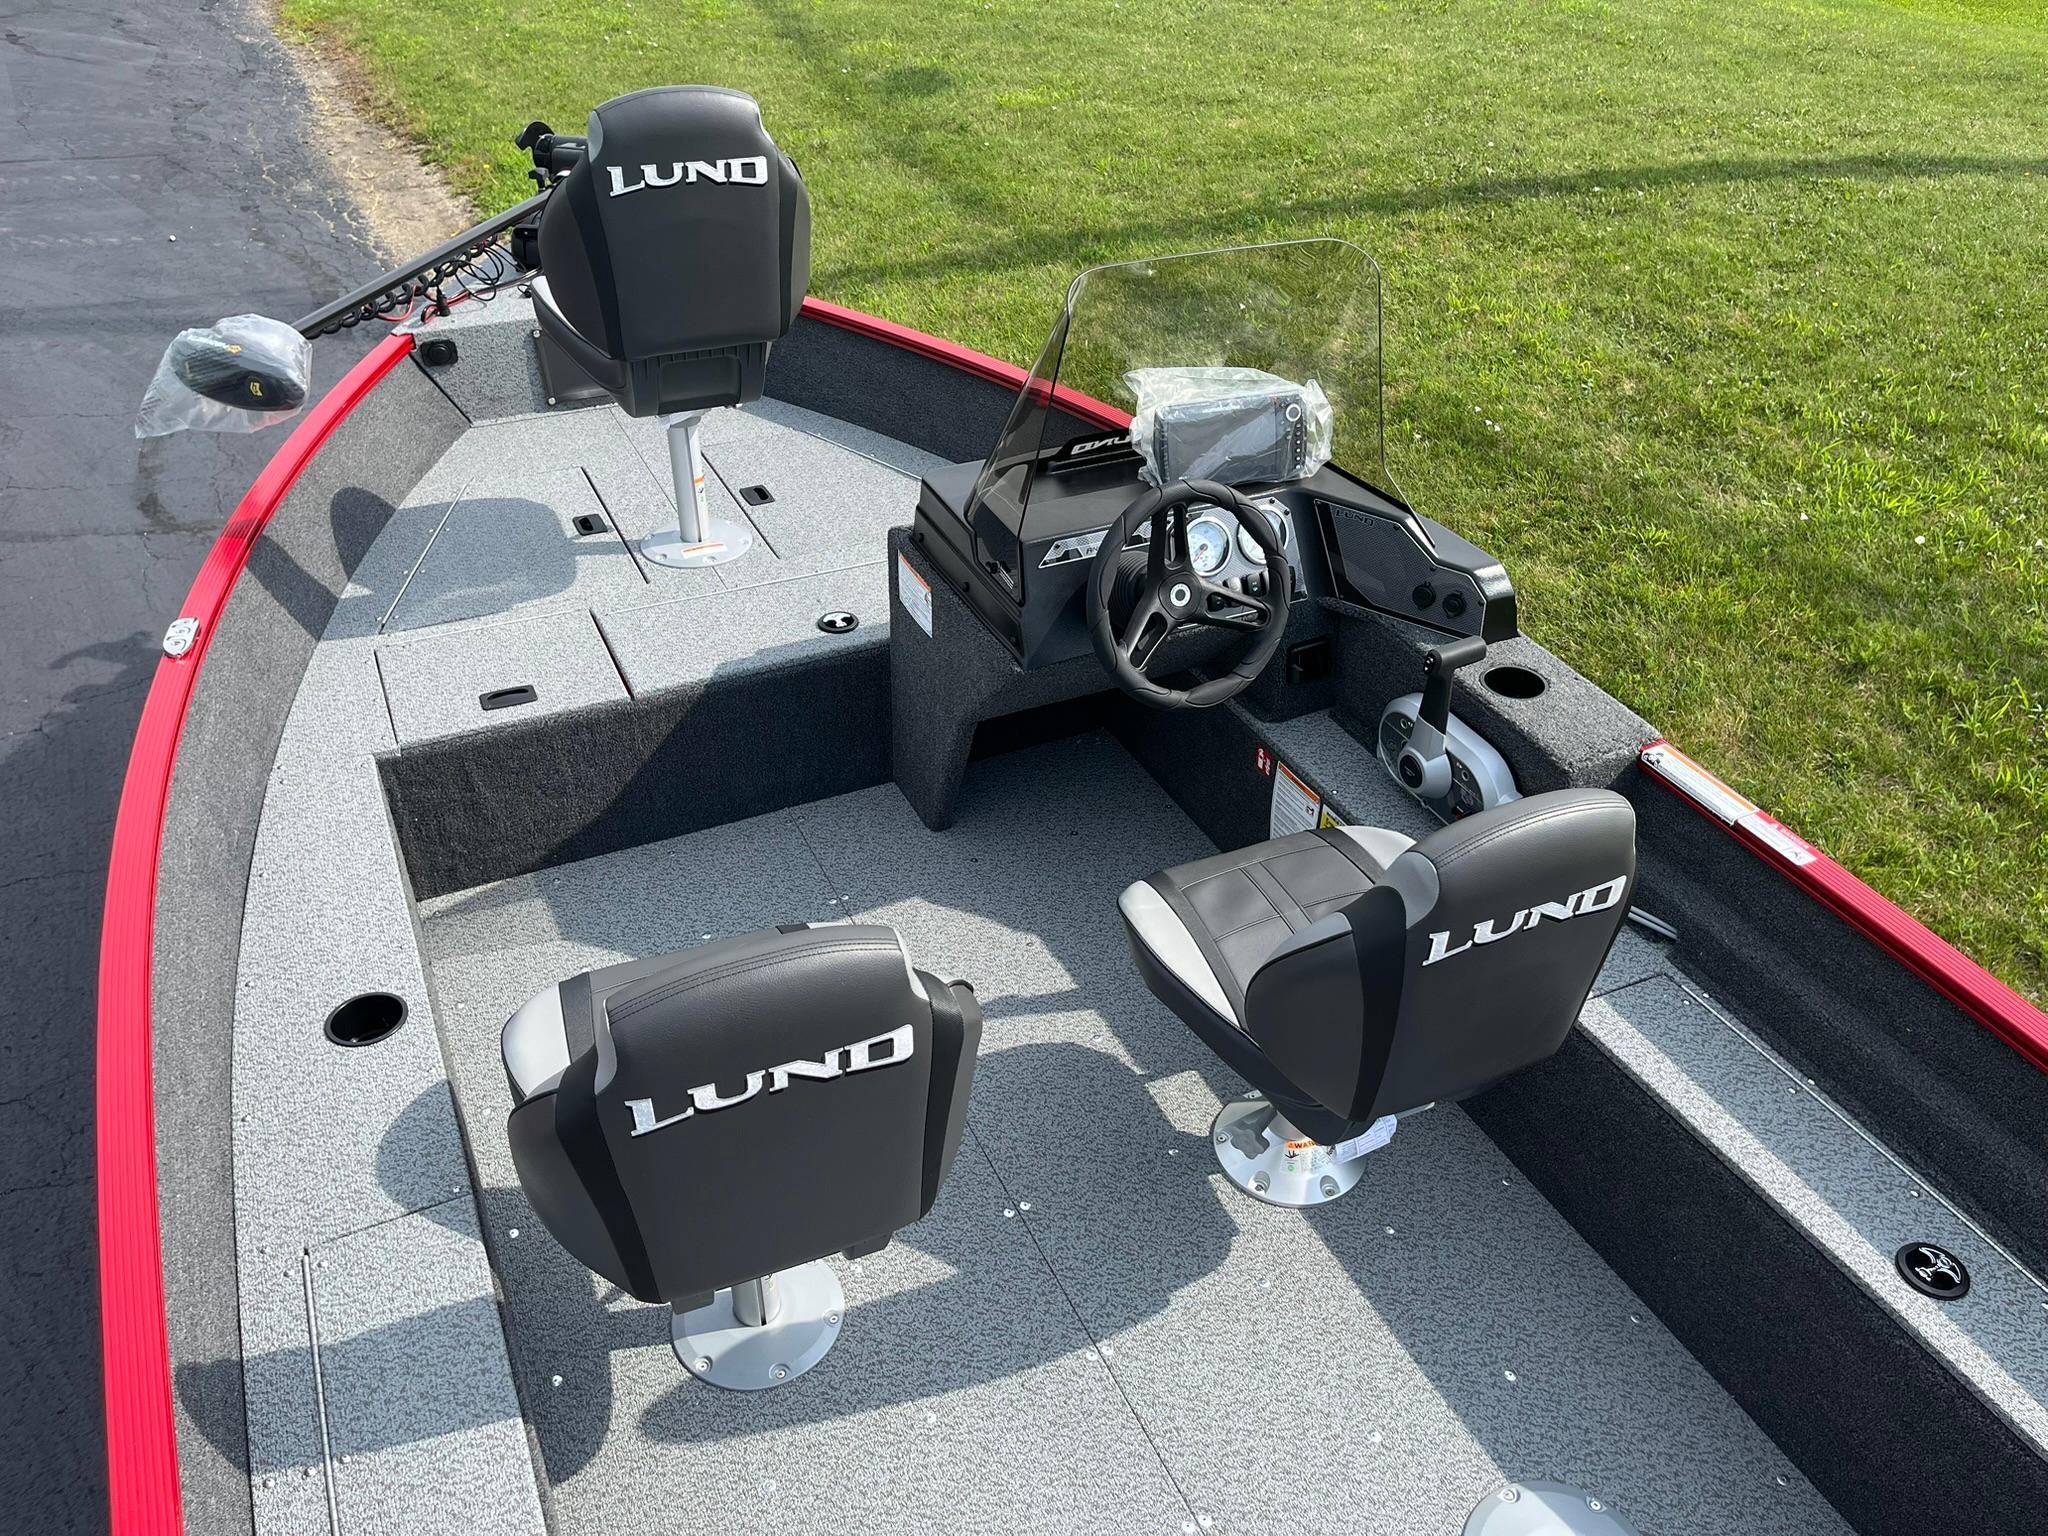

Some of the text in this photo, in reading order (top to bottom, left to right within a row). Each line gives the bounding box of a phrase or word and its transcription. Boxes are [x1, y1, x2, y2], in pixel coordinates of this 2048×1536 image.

[606, 155, 768, 197] LUND
[1335, 508, 1375, 527] LUND
[1422, 875, 1627, 967] LUND
[624, 1023, 914, 1137] LUND
